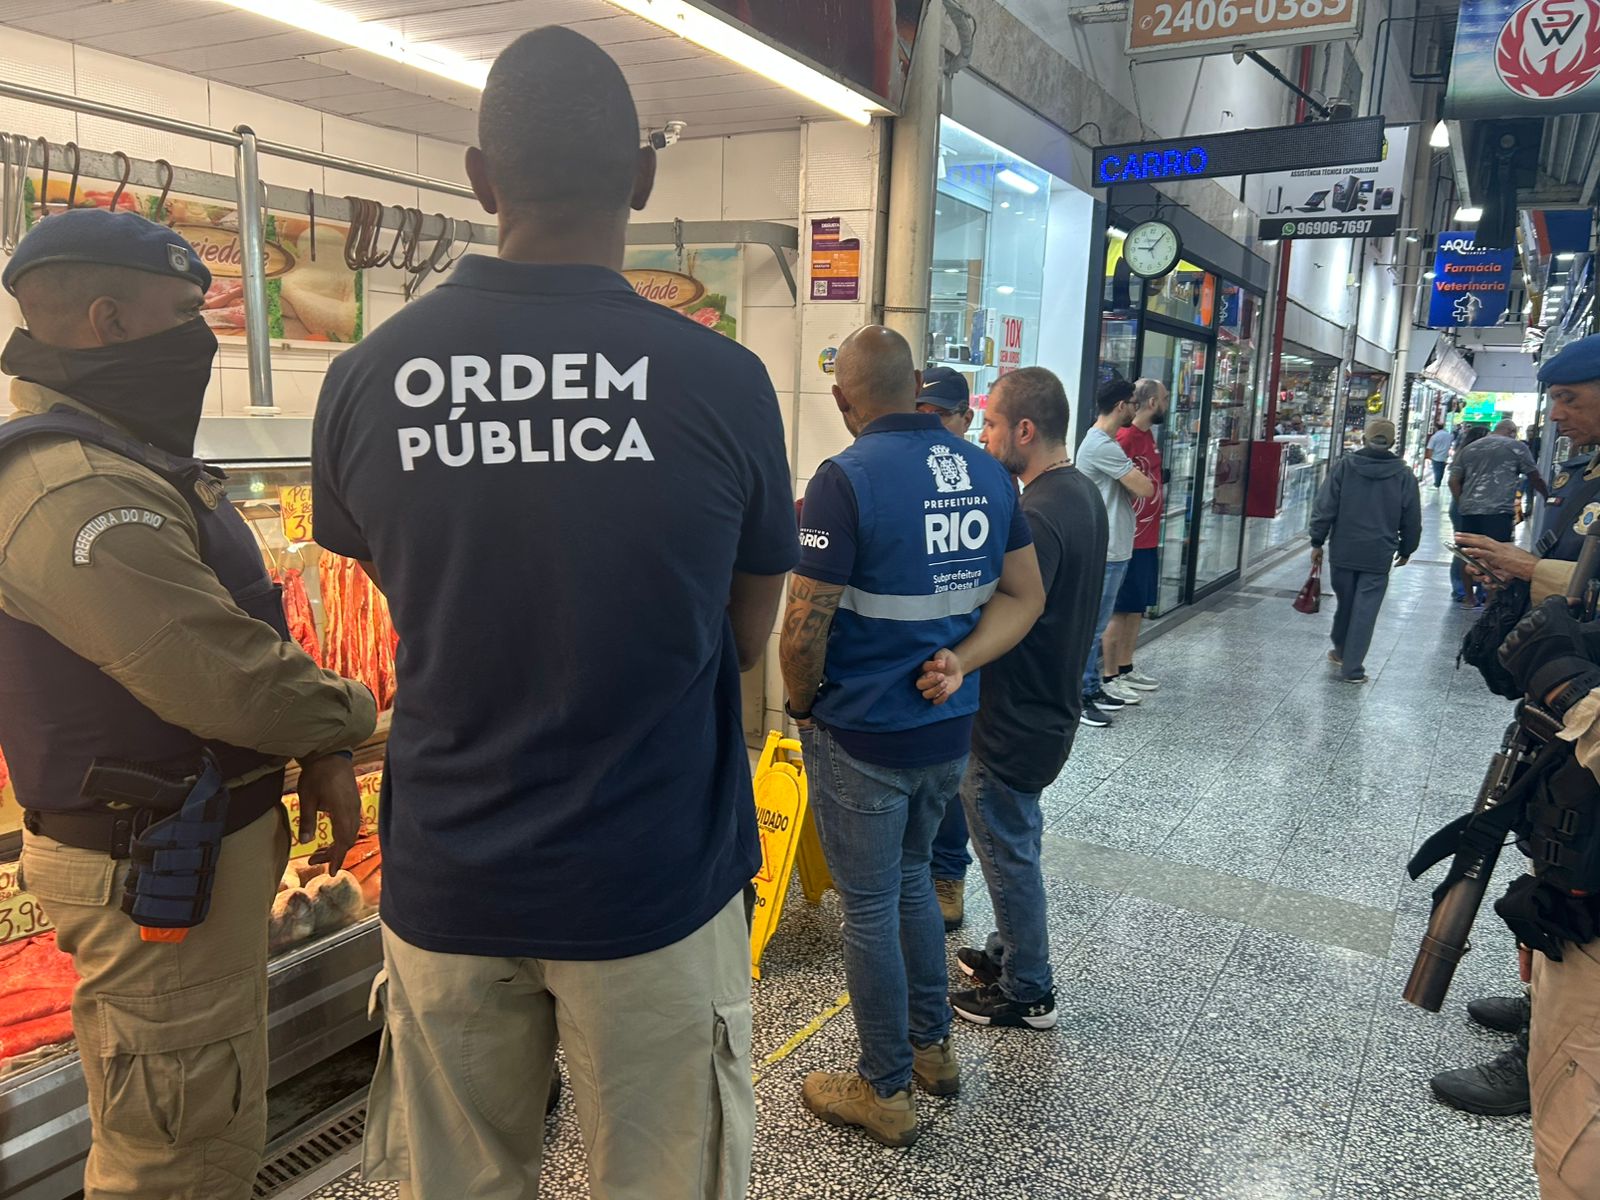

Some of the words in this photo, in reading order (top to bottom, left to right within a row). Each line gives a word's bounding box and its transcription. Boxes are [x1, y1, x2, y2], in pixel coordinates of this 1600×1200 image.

[1100, 147, 1208, 182] CARRO
[1321, 167, 1342, 176] TÉCNICA
[1297, 220, 1372, 235] 96906-7697
[1444, 262, 1502, 273] Farmácia
[1436, 281, 1505, 291] Veterinária
[394, 352, 649, 408] ORDEM
[397, 407, 655, 471] PÚBLICA
[924, 497, 988, 509] PREFEITURA
[75, 513, 118, 564] PREFEITURA
[121, 509, 139, 522] DO
[143, 511, 161, 527] RIO
[925, 510, 989, 554] RIO
[803, 533, 829, 549] RIO
[933, 569, 982, 584] Subprefeitura
[934, 584, 949, 594] Zona
[949, 581, 973, 591] Oeste
[756, 806, 789, 832] UIDADO
